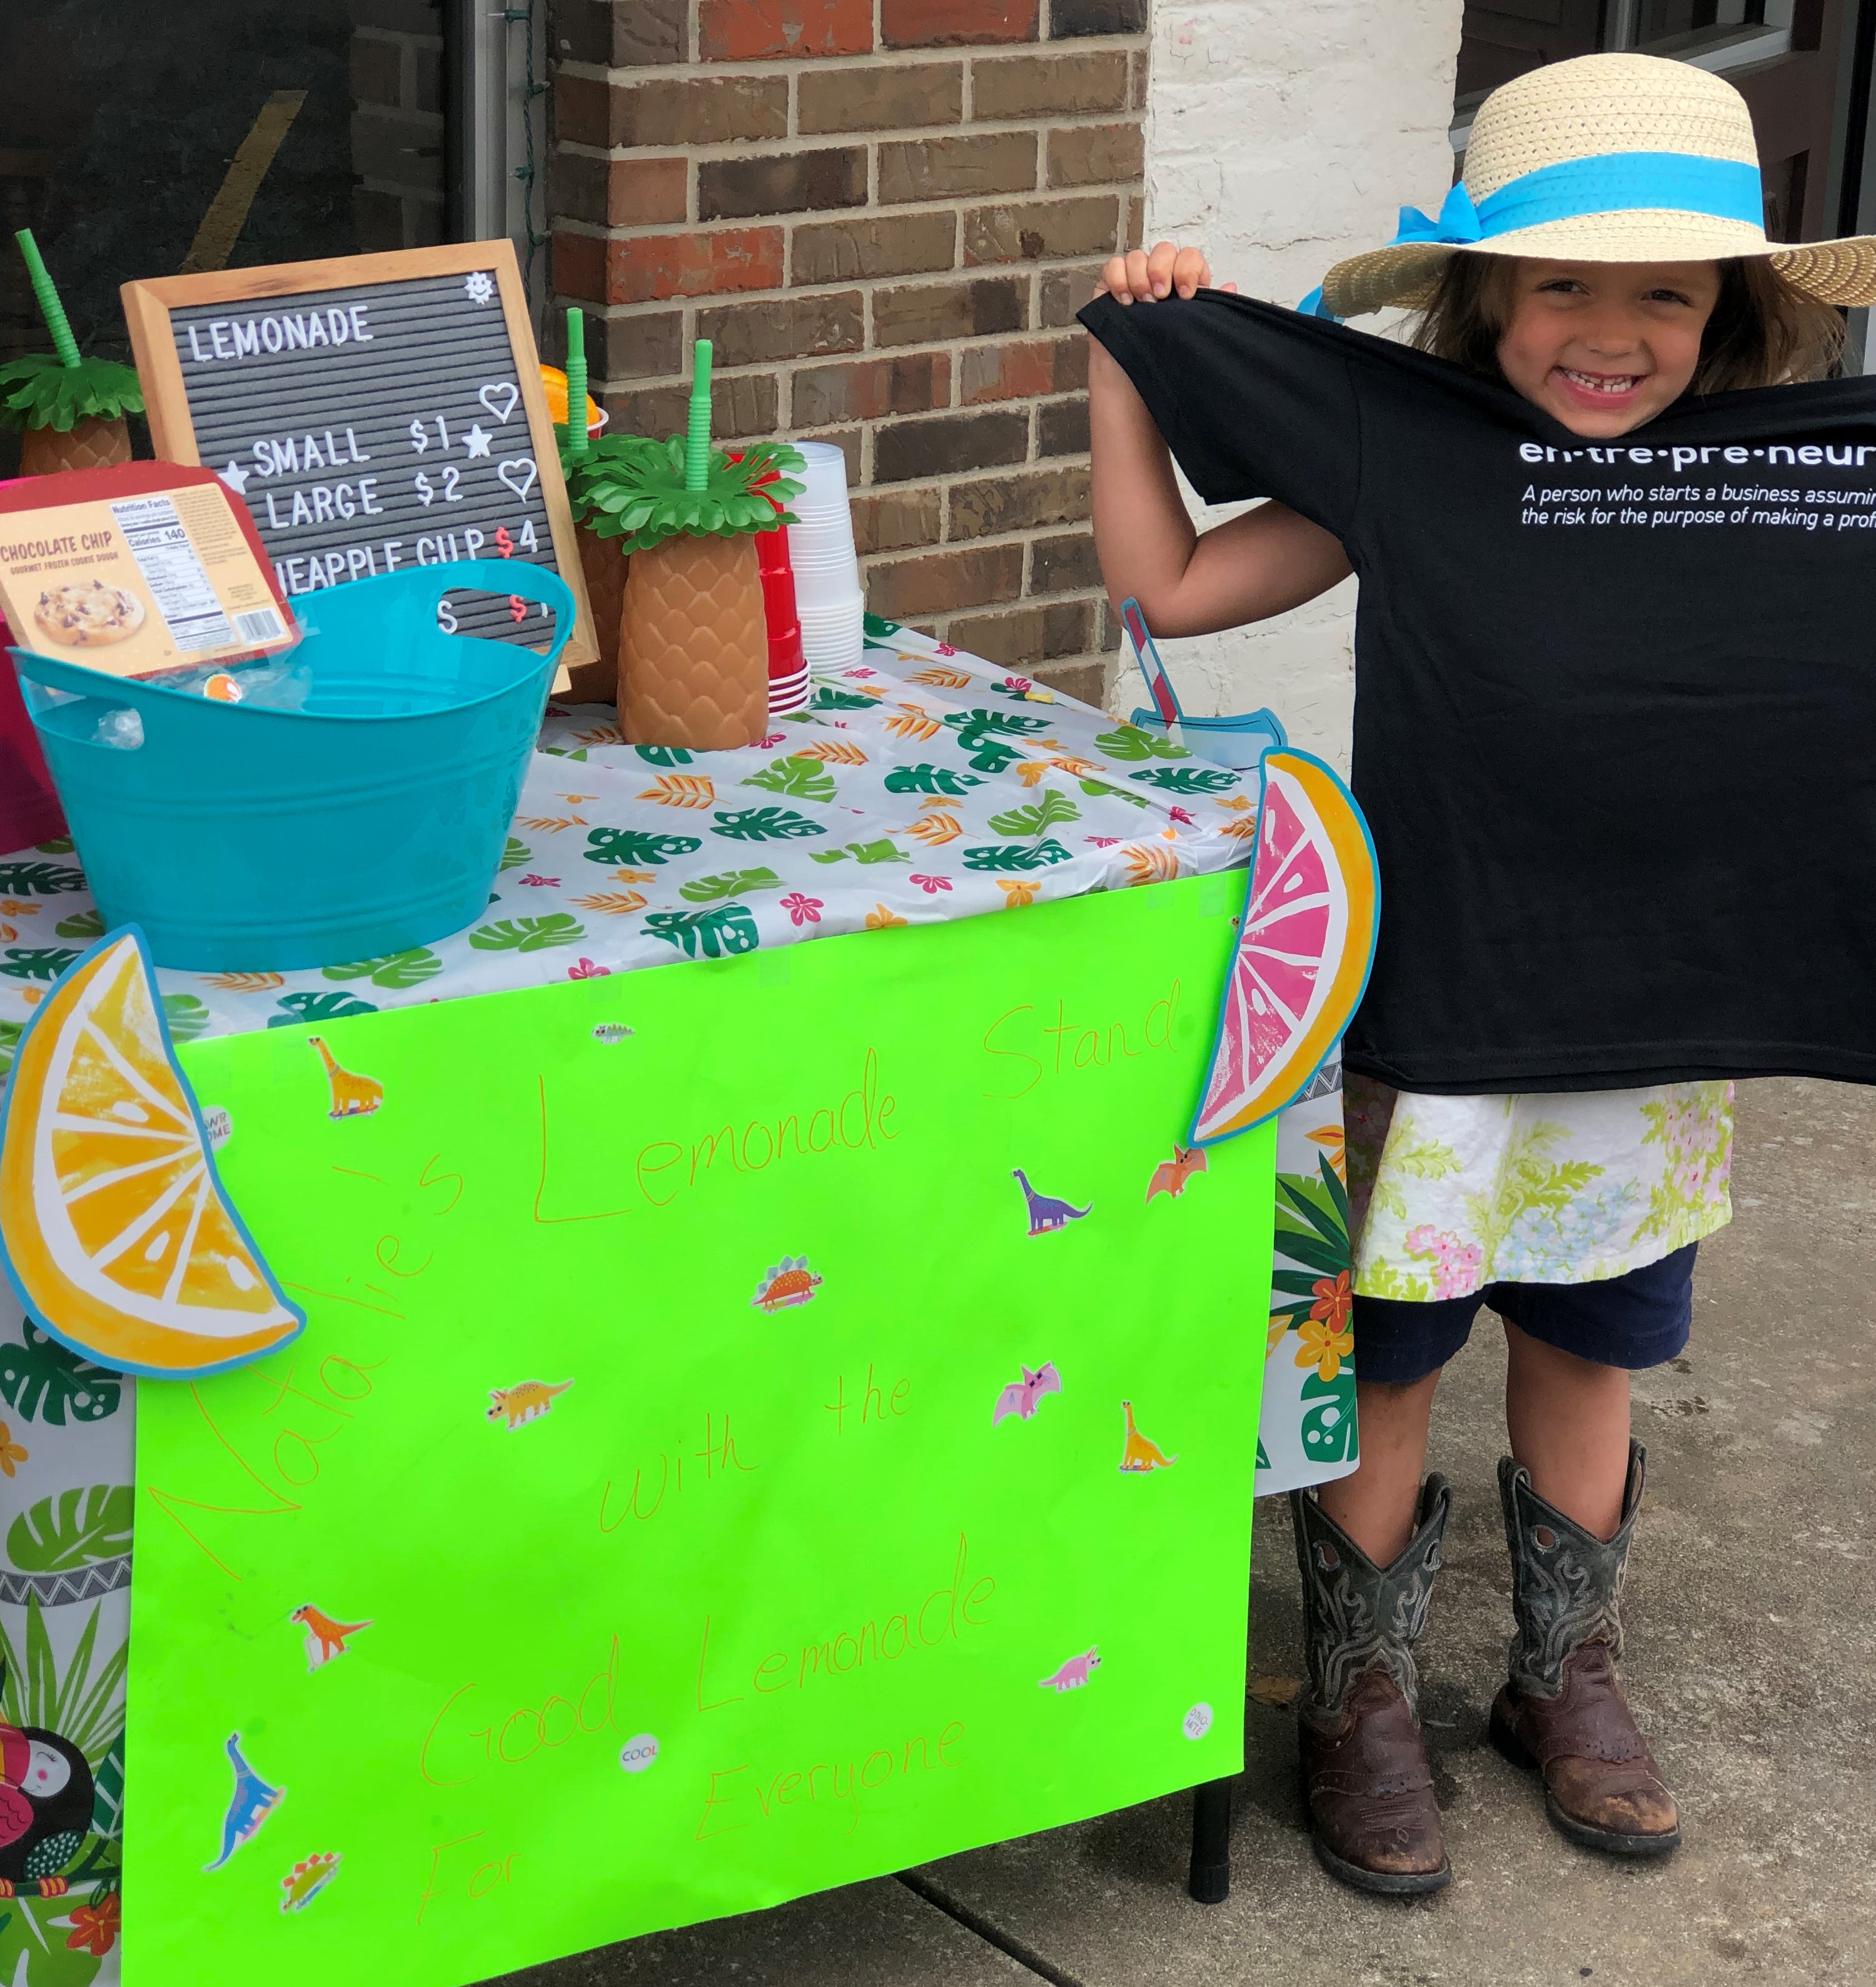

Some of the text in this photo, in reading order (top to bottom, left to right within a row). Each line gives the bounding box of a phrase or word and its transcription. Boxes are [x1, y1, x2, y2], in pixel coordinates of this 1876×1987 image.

[188, 305, 373, 362] LEMONADE
[253, 428, 371, 477] SMALL
[148, 498, 171, 508] Facts
[266, 478, 383, 529] LARGE
[1522, 484, 1536, 502] A
[1540, 488, 1602, 507] person
[1606, 483, 1644, 502] who
[1648, 485, 1701, 502] starts
[1705, 488, 1717, 500] a
[1722, 483, 1800, 502] business
[128, 535, 162, 548] Calories
[164, 527, 186, 541] 140
[1521, 506, 1876, 532] the risk for the purpose of making a prof
[0, 530, 113, 562] CHOCOLATE CHIP
[10, 551, 119, 575] GOURMET FROZEN COOKIE DOUGH
[534, 1046, 900, 1224] Lemonade
[982, 978, 1181, 1099] Stand
[824, 1362, 914, 1437] the
[421, 1532, 996, 1786] Good Lemonade
[622, 1744, 657, 1762] COOL
[416, 1721, 969, 1926] For Everyone
